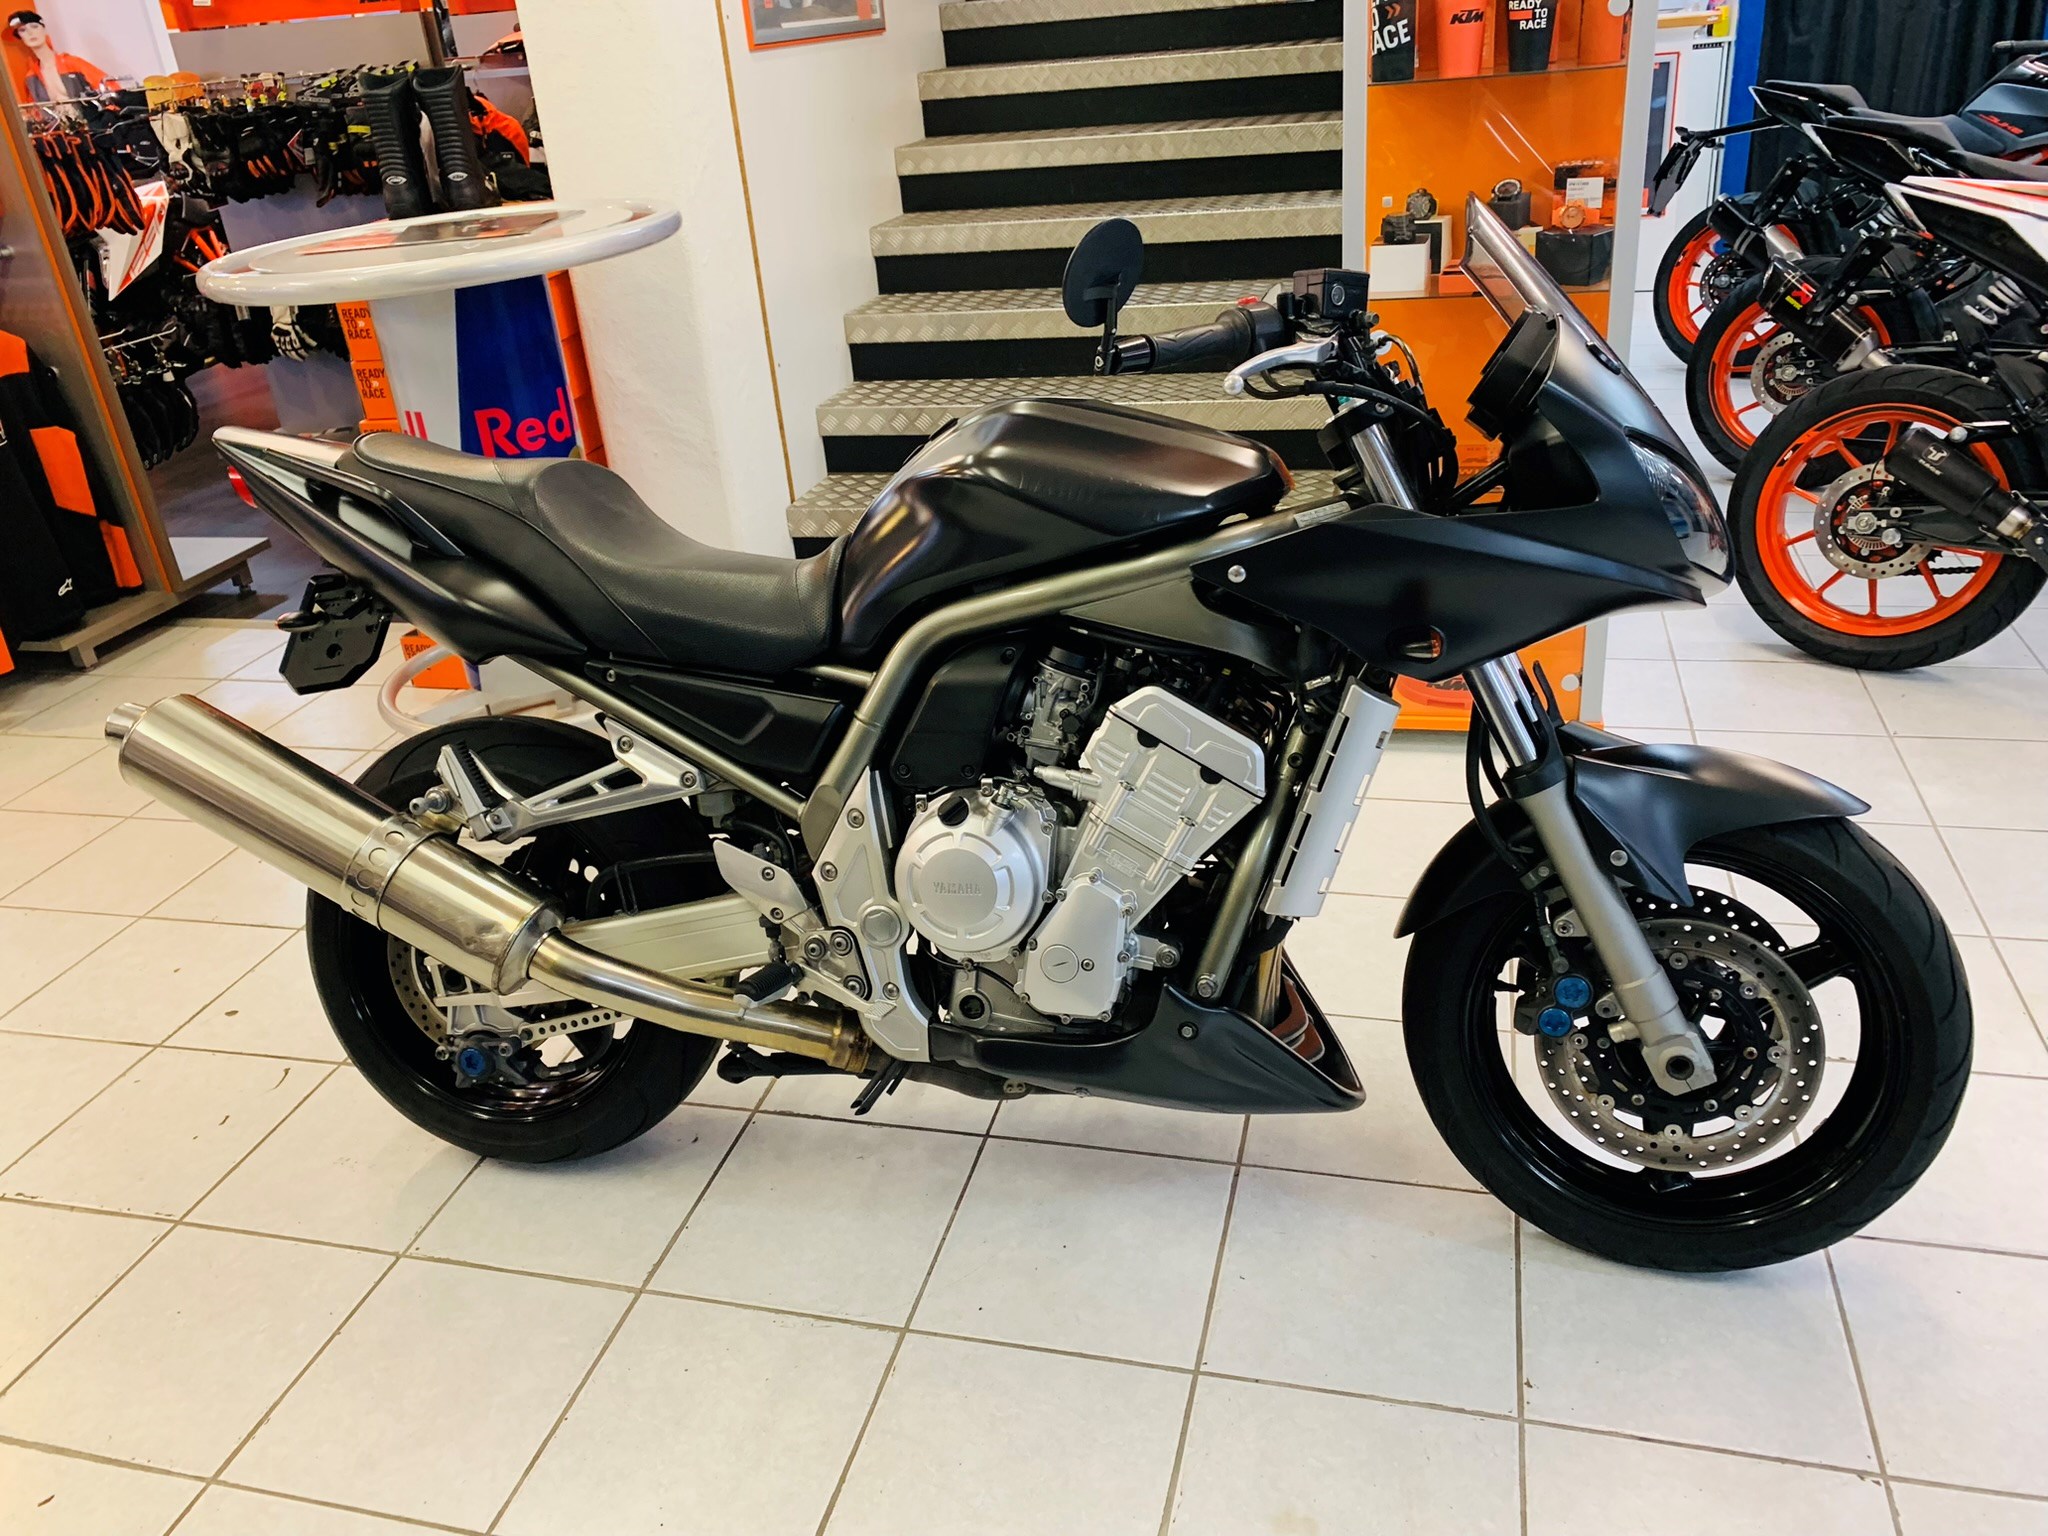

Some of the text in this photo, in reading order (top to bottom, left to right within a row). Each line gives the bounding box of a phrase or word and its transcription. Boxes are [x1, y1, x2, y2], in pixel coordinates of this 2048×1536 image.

[1508, 0, 1541, 10] READY
[1450, 9, 1484, 24] KTM
[1534, 8, 1548, 18] TO
[1519, 19, 1547, 30] RACE
[1372, 18, 1411, 56] ACE
[346, 319, 357, 329] TO
[348, 328, 373, 340] RACE
[356, 368, 386, 380] READY
[360, 379, 372, 390] TO
[362, 388, 387, 399] RACE
[474, 387, 573, 458] Red
[932, 881, 983, 896] YAMAHA
